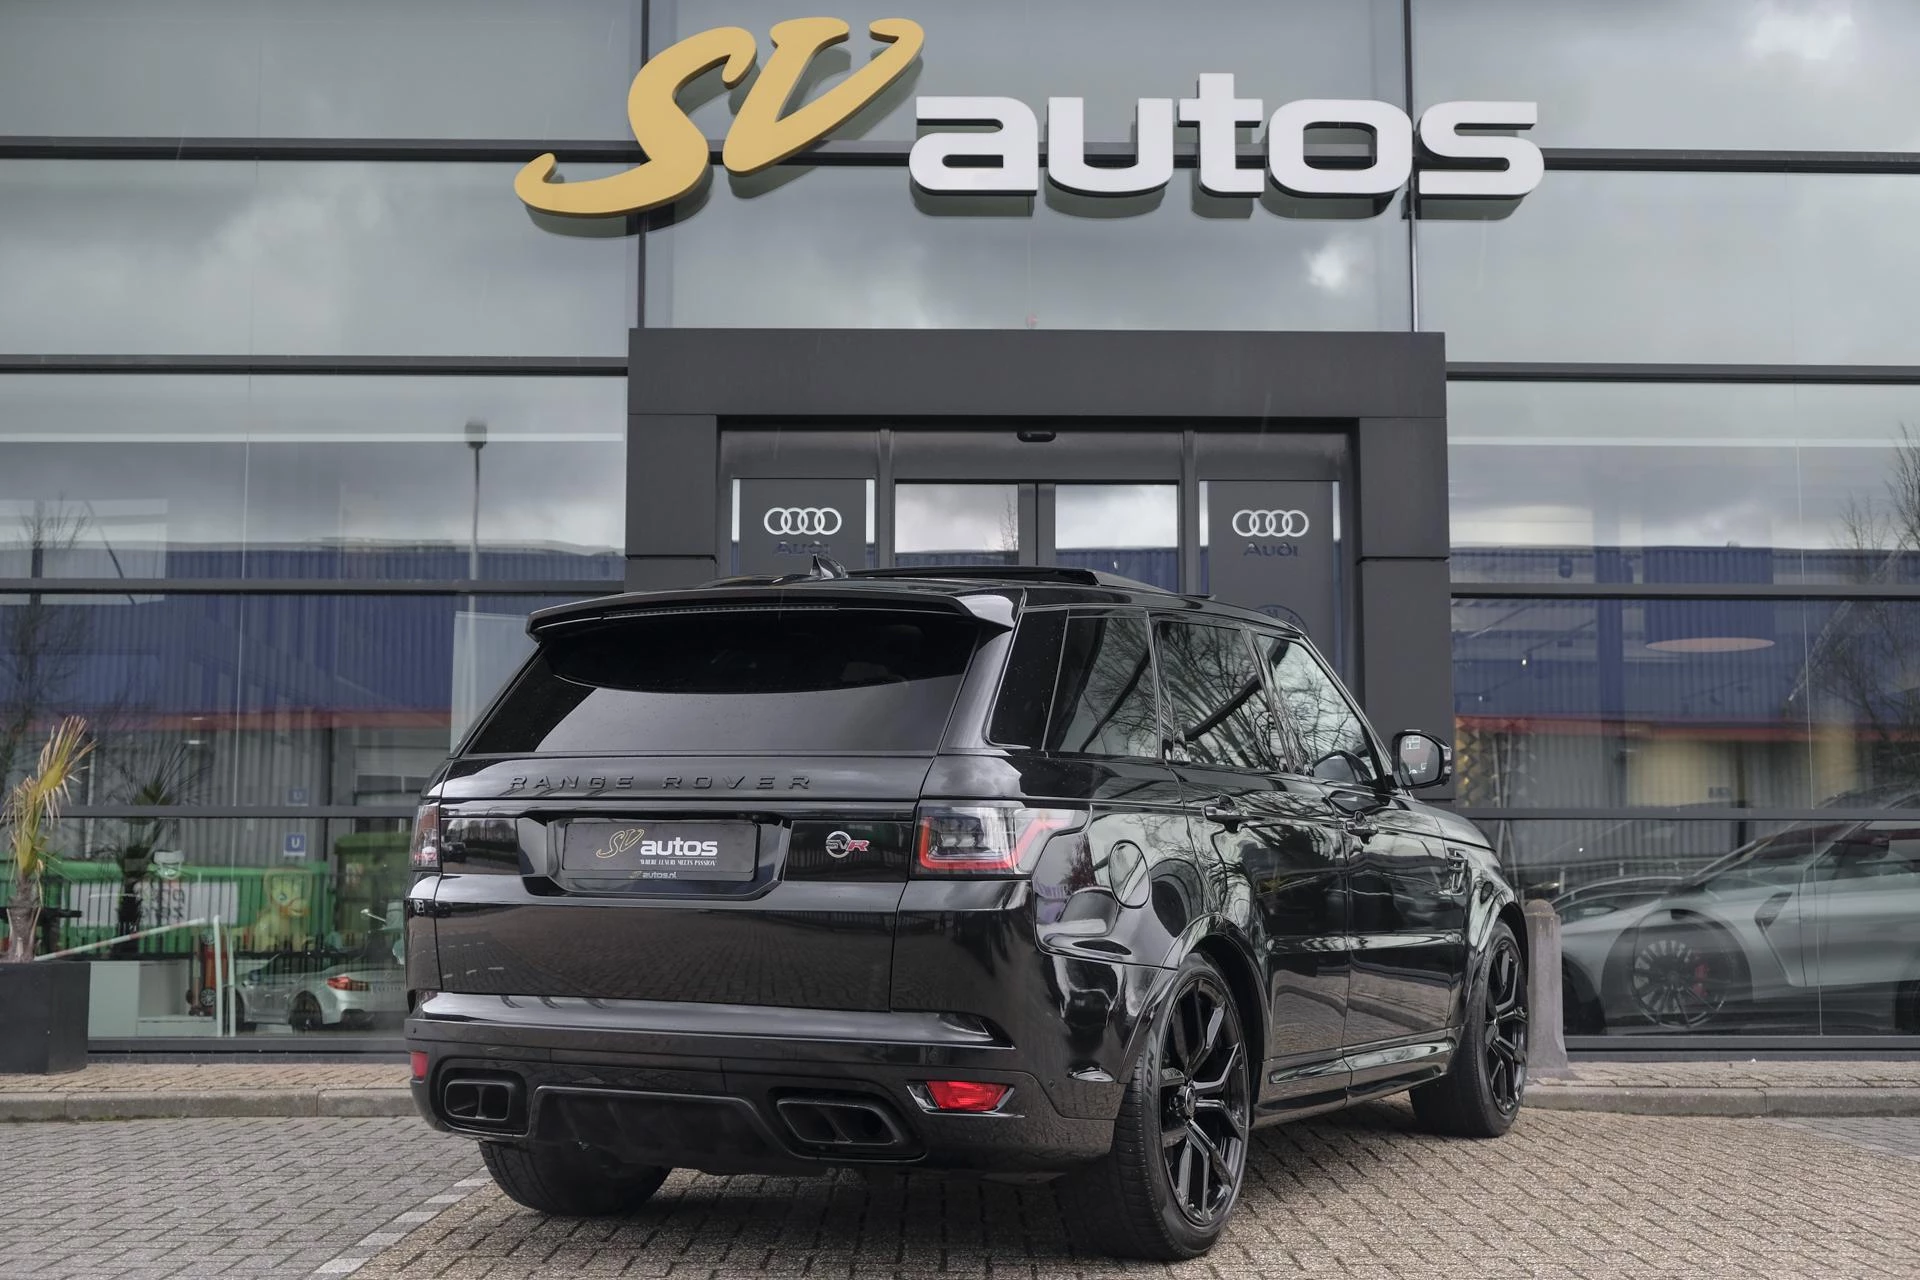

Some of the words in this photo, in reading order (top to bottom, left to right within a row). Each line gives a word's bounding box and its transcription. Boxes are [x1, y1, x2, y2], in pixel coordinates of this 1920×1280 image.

[514, 17, 925, 218] SV
[909, 73, 1544, 196] autos
[509, 775, 635, 790] RANGE
[661, 775, 811, 790] ROVER
[596, 829, 645, 858] SV
[640, 837, 718, 856] autos
